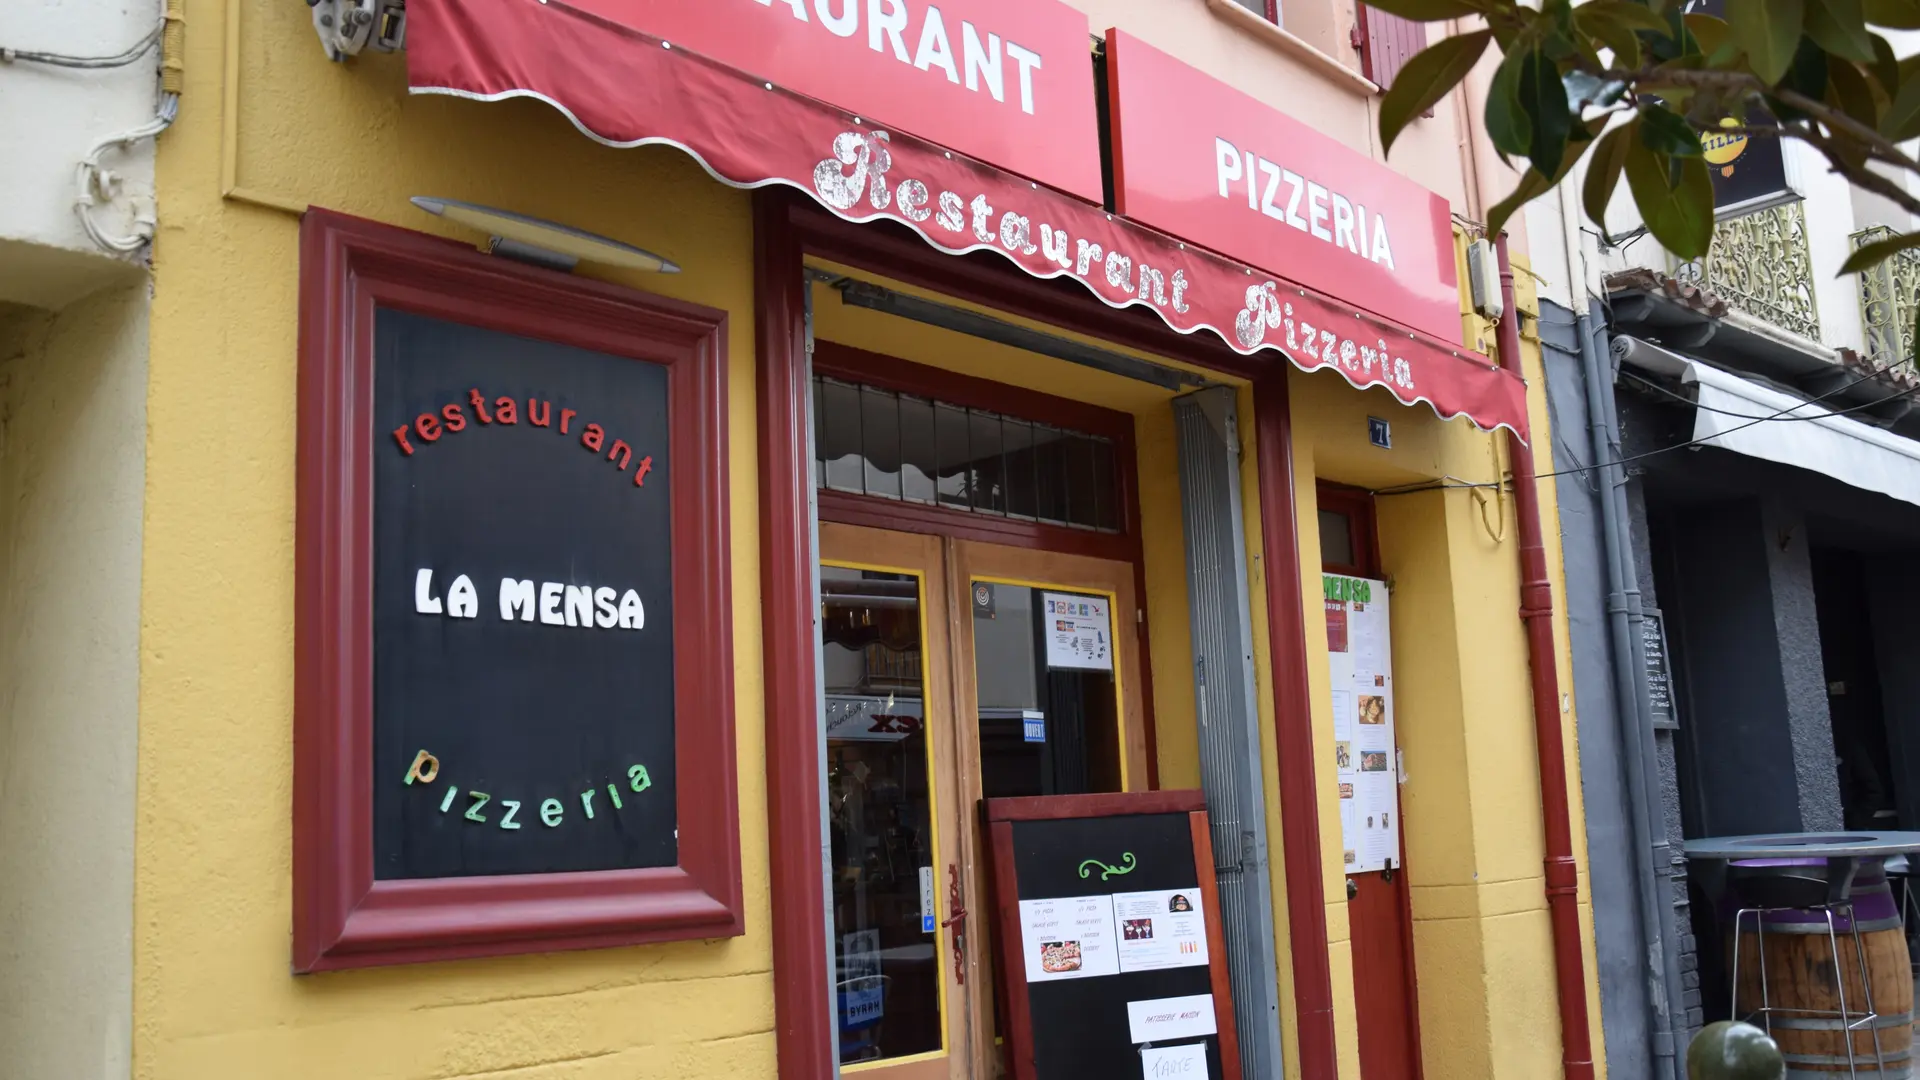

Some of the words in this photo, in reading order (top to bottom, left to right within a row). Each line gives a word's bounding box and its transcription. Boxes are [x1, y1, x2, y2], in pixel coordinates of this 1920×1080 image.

[1215, 136, 1396, 271] PIZZERIA
[813, 130, 1189, 314] Restaurant
[1236, 281, 1415, 391] Pizzeria
[392, 387, 653, 488] restaurant
[1376, 423, 1384, 444] 7
[415, 568, 479, 618] LA
[499, 577, 645, 630] MENSA
[1322, 576, 1371, 603] MENSA
[403, 749, 652, 830] pizzeria
[1151, 1055, 1194, 1079] TARTE
